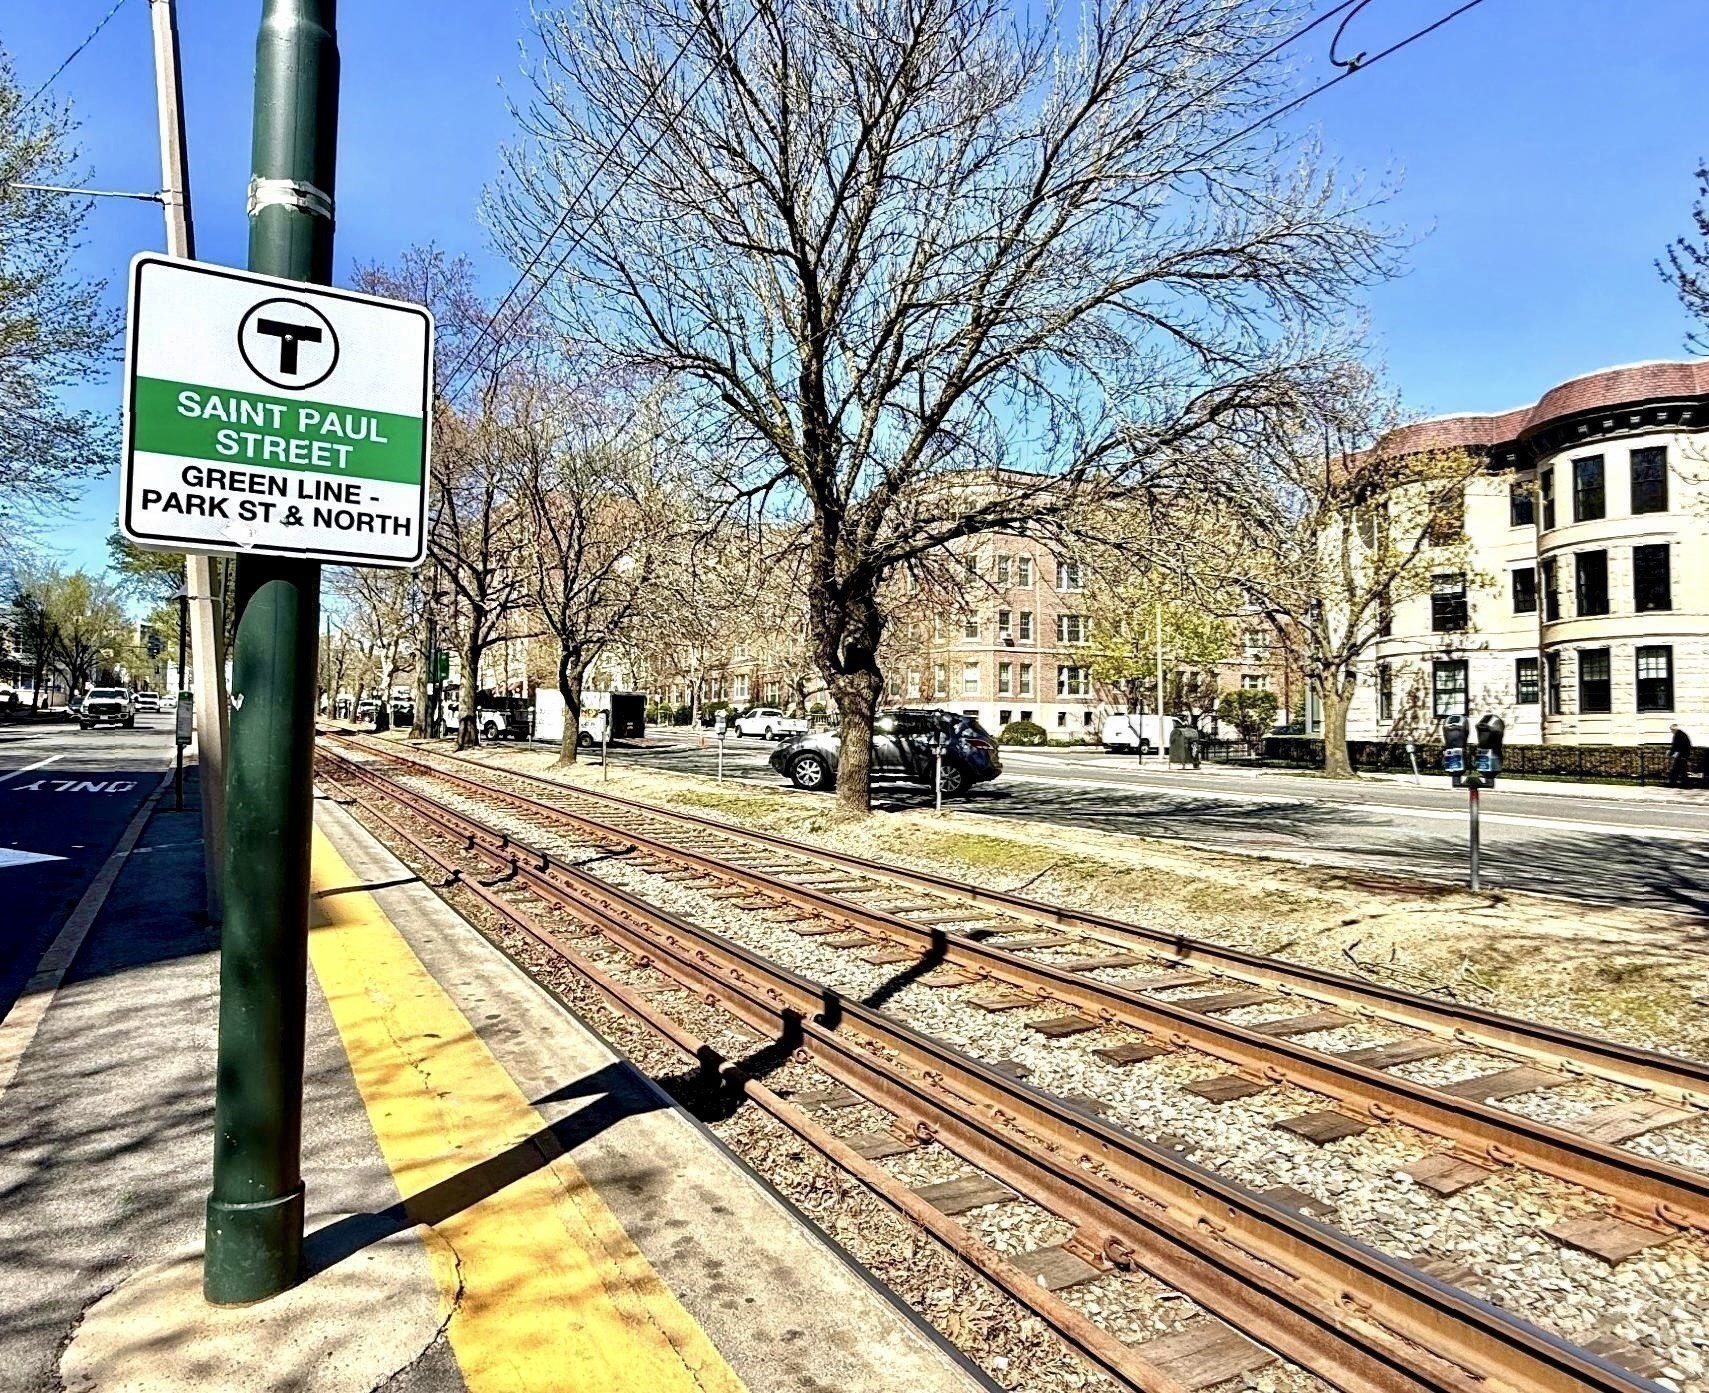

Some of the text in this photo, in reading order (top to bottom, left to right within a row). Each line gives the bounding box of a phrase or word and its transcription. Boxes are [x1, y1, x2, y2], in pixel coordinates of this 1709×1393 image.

[257, 317, 322, 375] T
[177, 391, 388, 443] SAINT PAUL
[215, 429, 354, 469] STREET
[182, 465, 287, 498] GREEN
[298, 478, 361, 505] LINE
[141, 488, 411, 537] PARK ST & NORTH
[10, 780, 137, 792] ONLY
